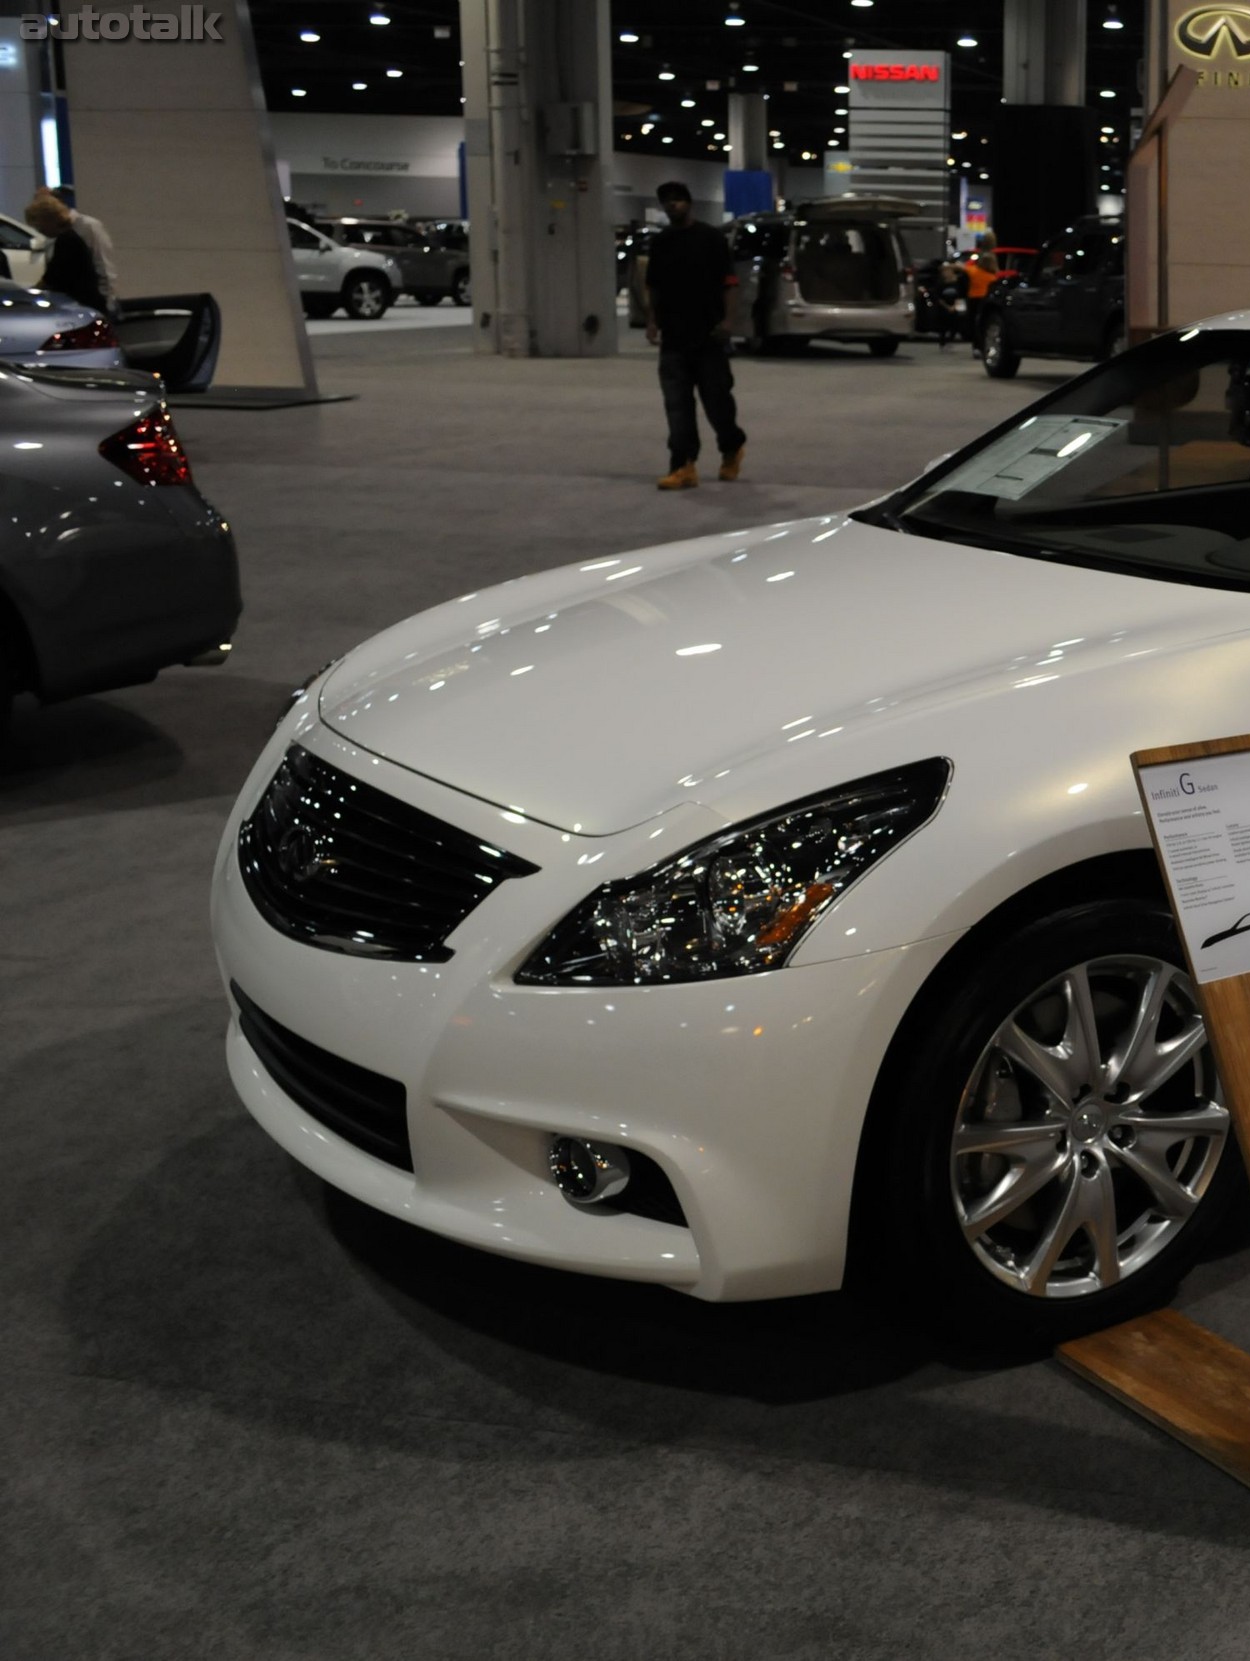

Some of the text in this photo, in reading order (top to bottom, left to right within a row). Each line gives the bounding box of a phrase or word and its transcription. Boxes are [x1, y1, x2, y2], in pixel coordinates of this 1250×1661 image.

[849, 64, 939, 81] NISSAN
[322, 157, 410, 171] To Concourse
[1151, 773, 1218, 800] Infiniti G Sedan
